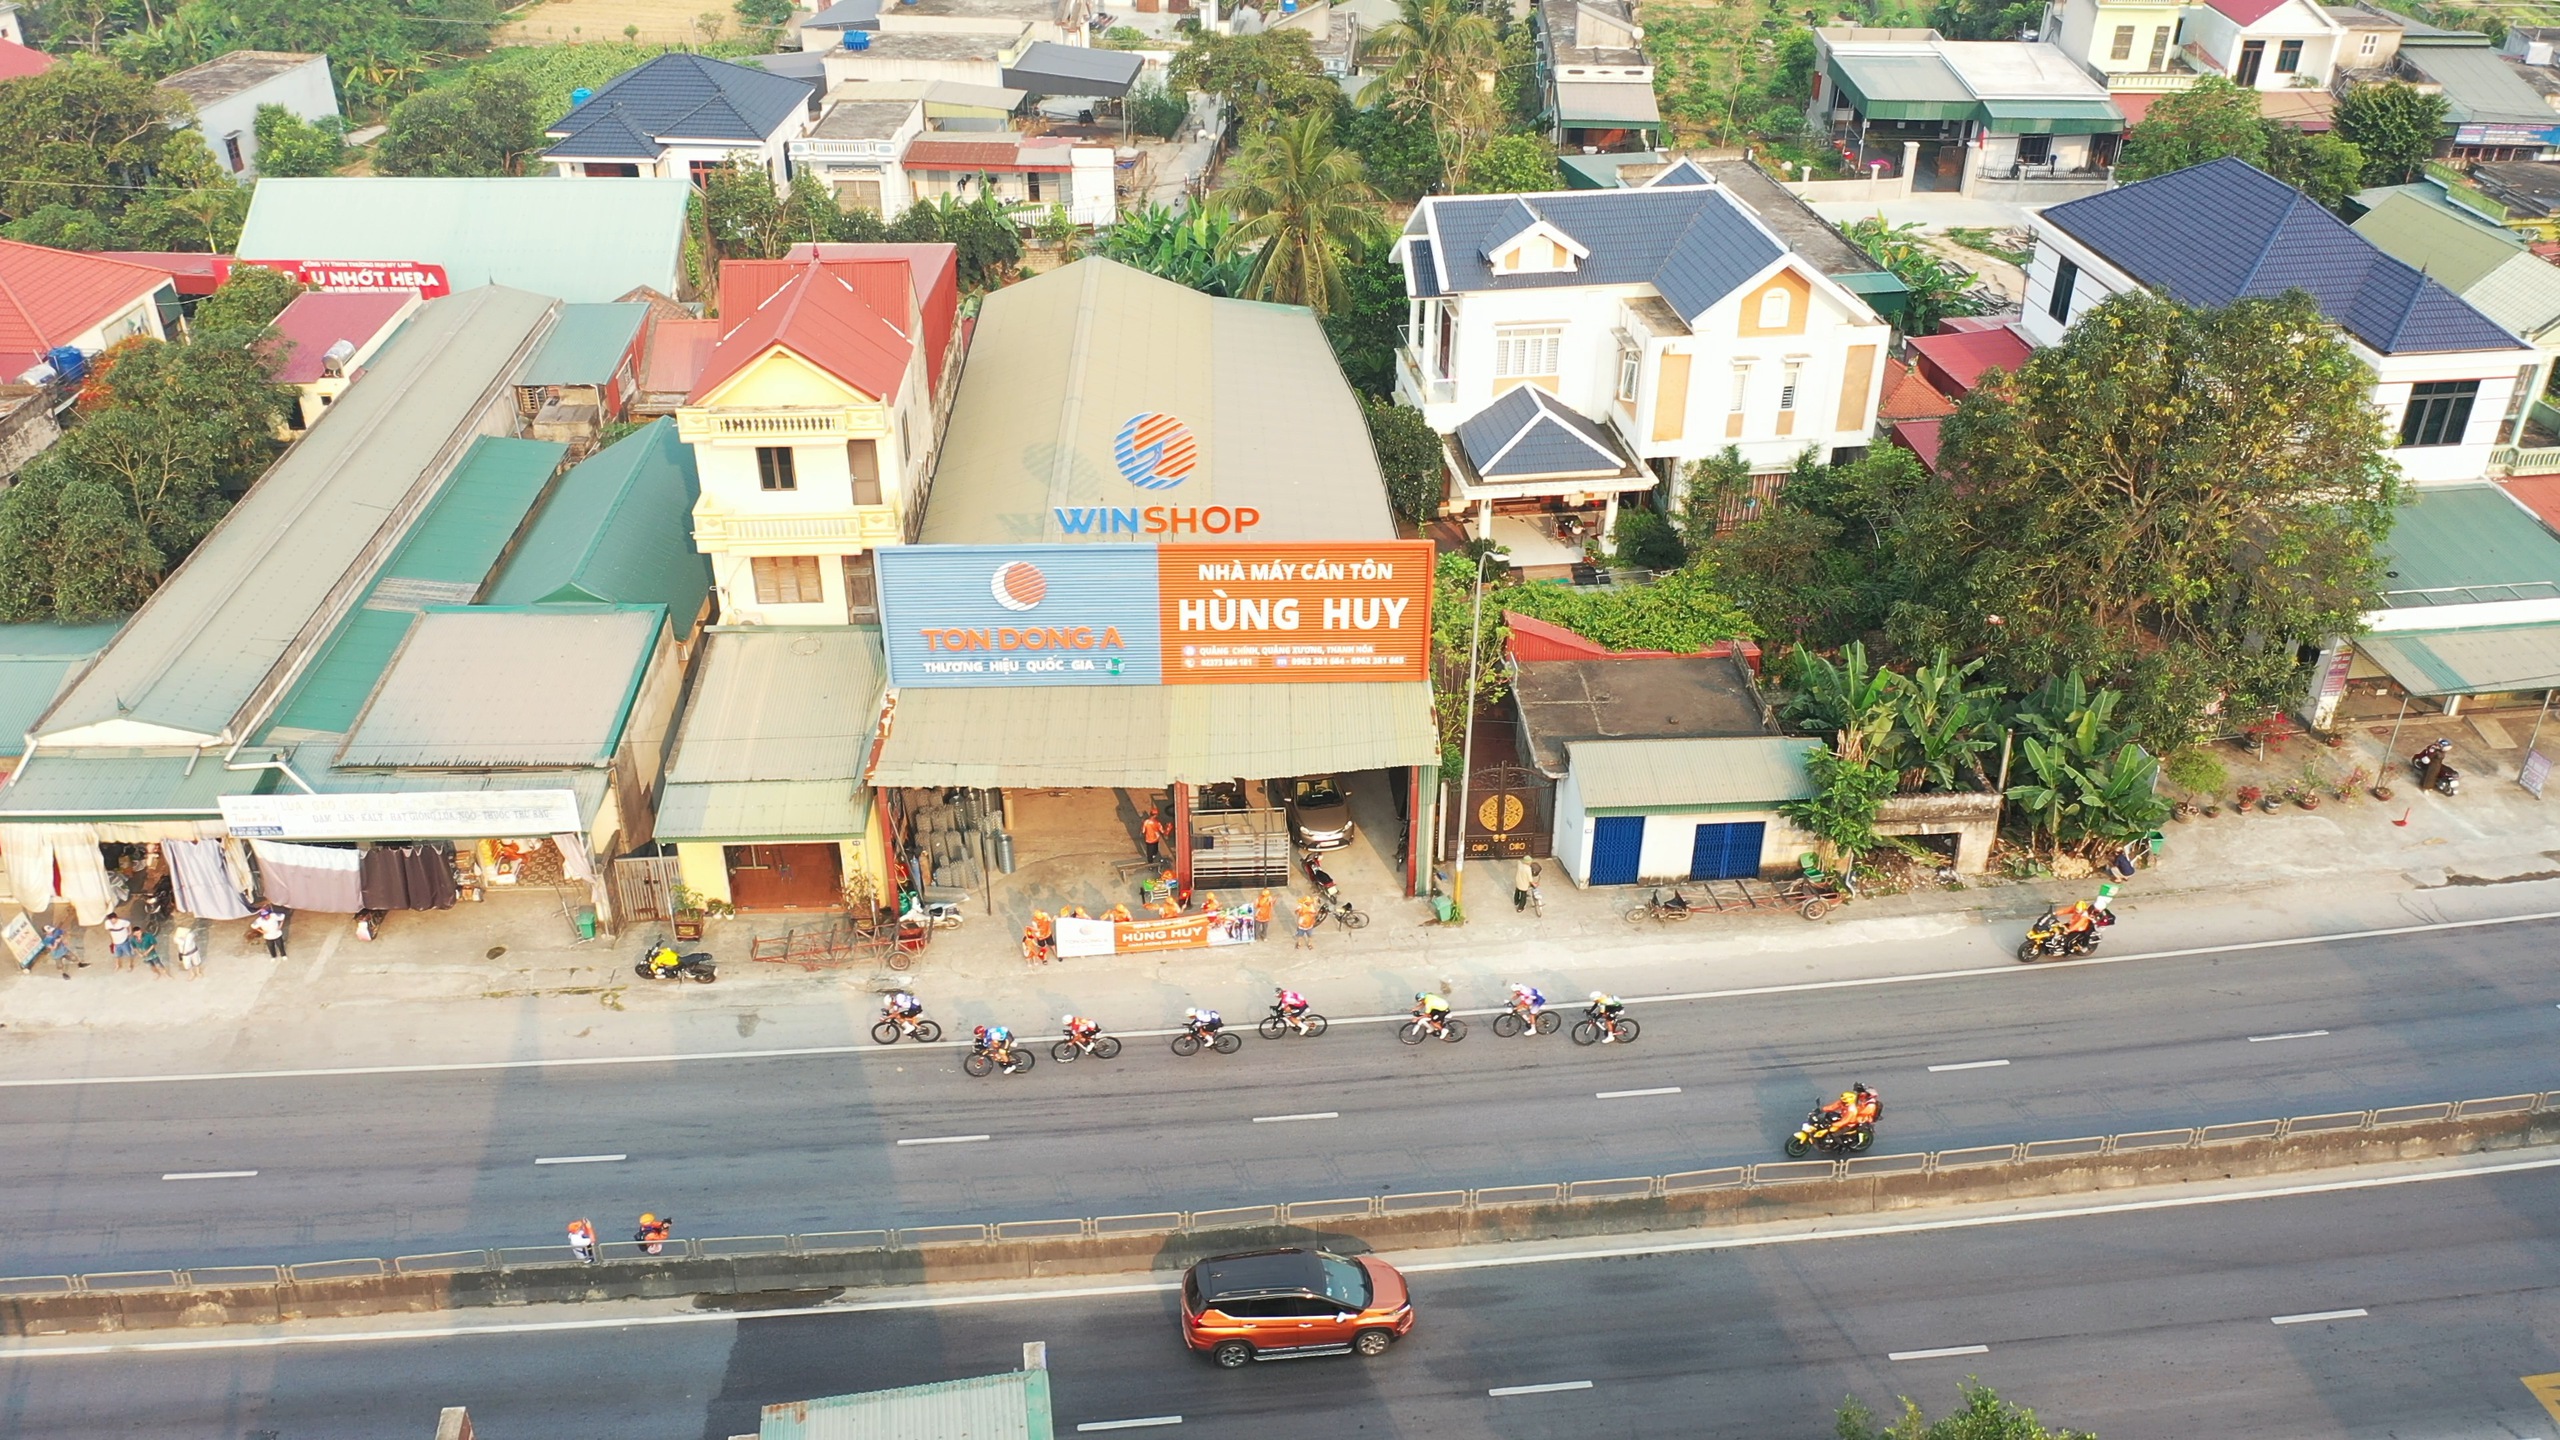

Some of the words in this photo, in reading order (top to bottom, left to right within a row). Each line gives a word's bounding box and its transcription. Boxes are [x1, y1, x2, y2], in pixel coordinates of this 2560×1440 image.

[329, 268, 385, 286] NHỚT
[390, 272, 439, 286] HERA
[1053, 505, 1260, 534] WINSHOP
[1198, 559, 1247, 582] NHÀ
[1250, 558, 1298, 582] MÁY
[1300, 559, 1346, 581] CÁN
[1349, 558, 1394, 580] TÔN
[1178, 590, 1300, 631] HÙNG
[1324, 597, 1410, 630] HUY
[1200, 645, 1228, 656] QUẢNG
[1262, 644, 1290, 656] QUẢNG
[924, 662, 983, 673] THƯƠNG
[990, 658, 1019, 676] HIỆU
[1026, 655, 1064, 672] QUỐC
[1072, 660, 1095, 671] GIA
[1122, 930, 1167, 942] HÙNG
[1171, 926, 1203, 938] HUY
